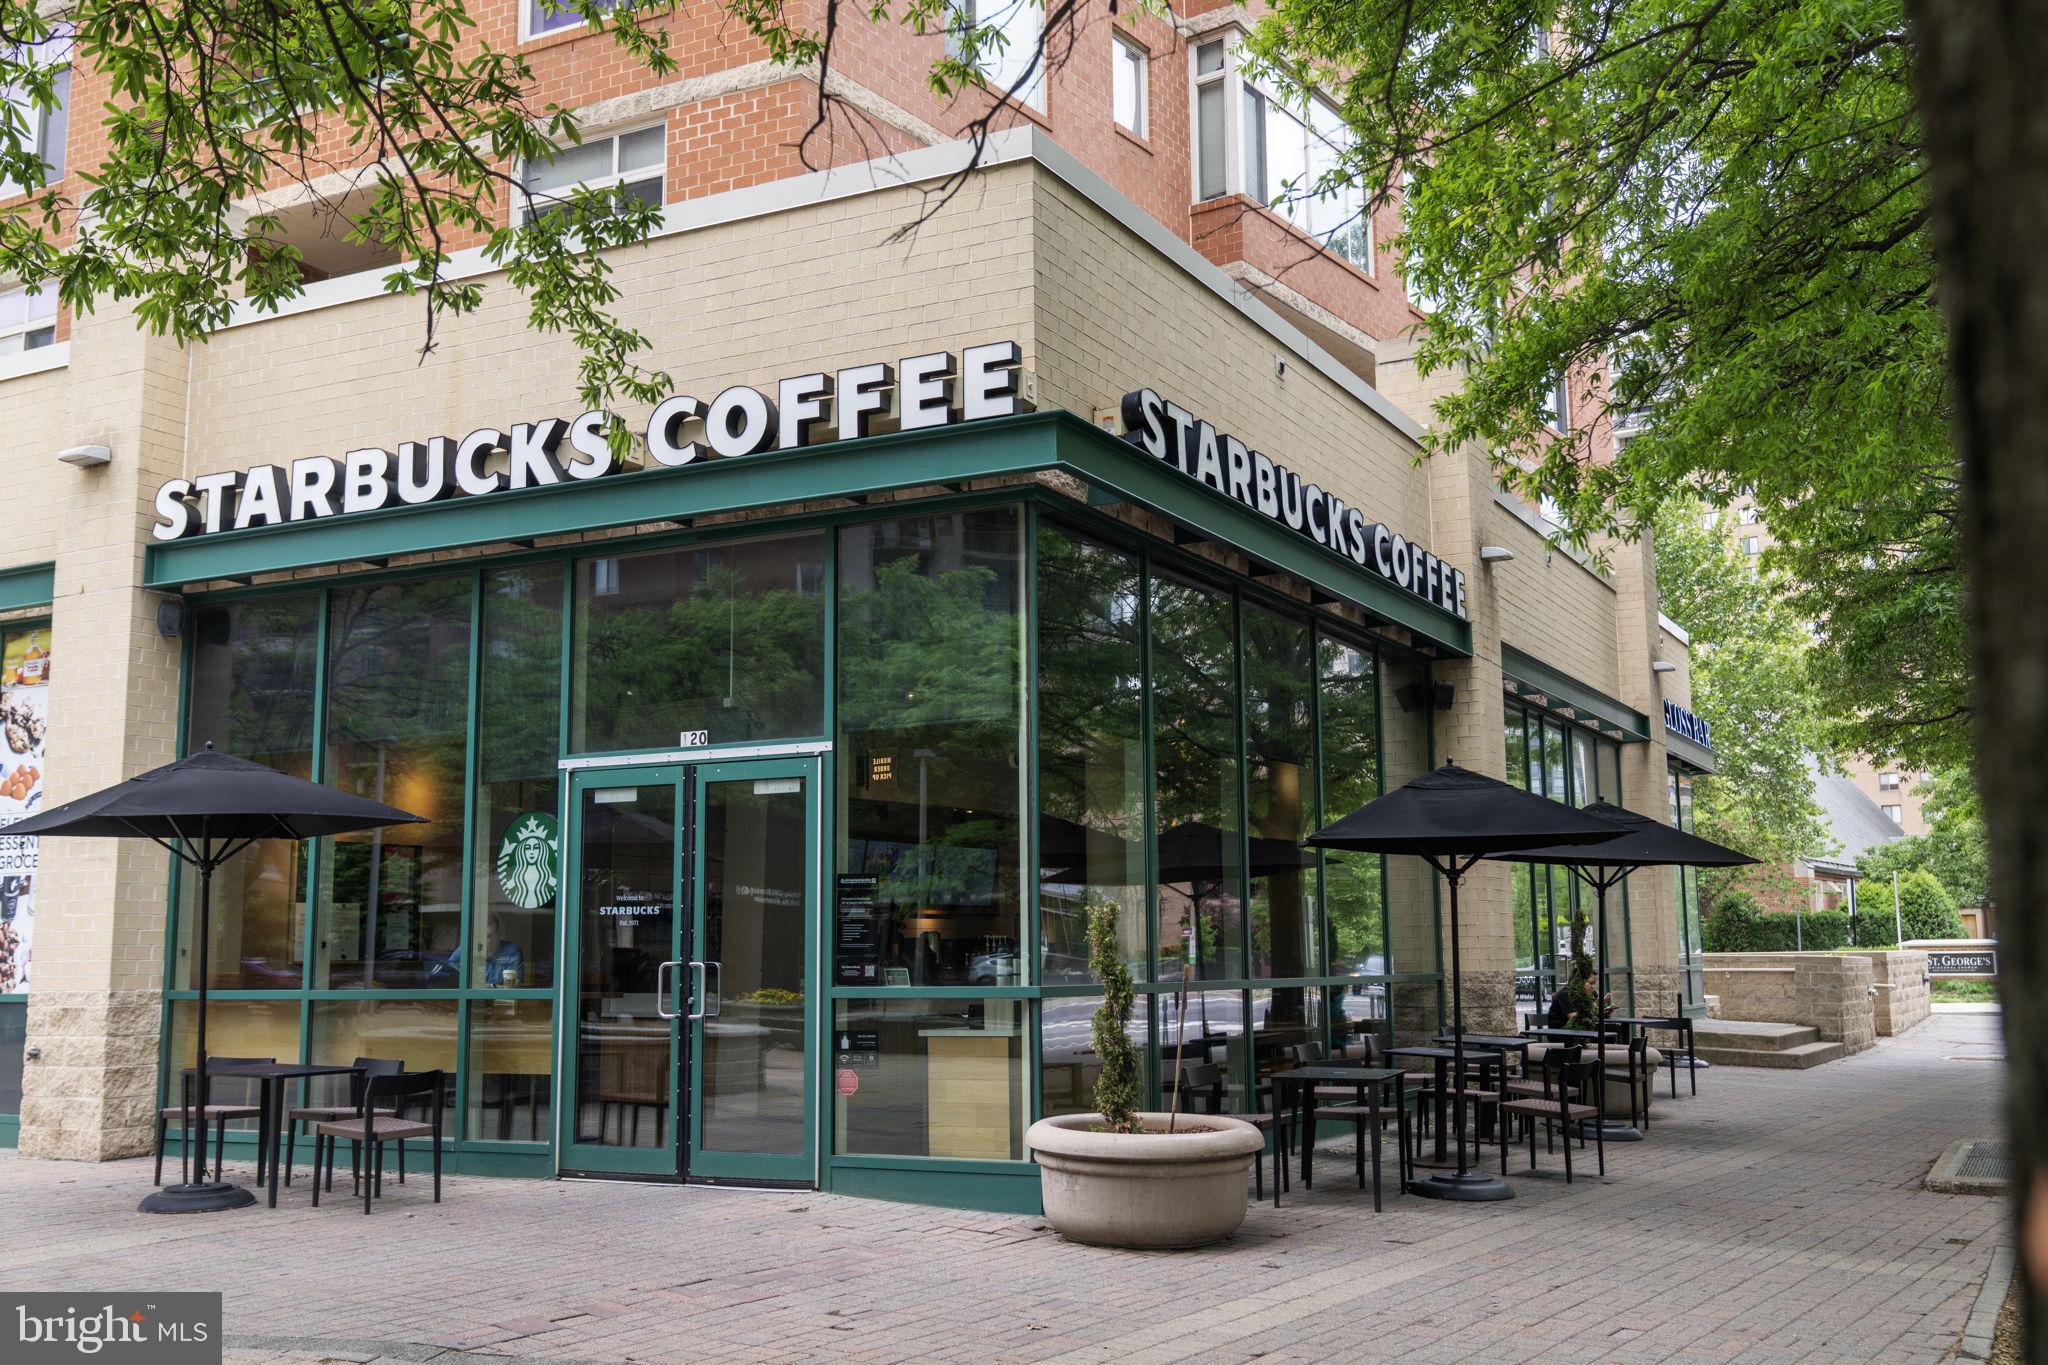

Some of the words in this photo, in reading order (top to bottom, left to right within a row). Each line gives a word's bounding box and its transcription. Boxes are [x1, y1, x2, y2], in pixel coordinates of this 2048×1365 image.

[152, 409, 624, 541] STARBUCKS
[646, 340, 1023, 467] COFFEE
[1122, 387, 1366, 566] STARBUCKS
[1367, 522, 1468, 620] COFFEE
[682, 731, 707, 746] 120
[1663, 696, 1692, 739] GLOSS
[1693, 714, 1712, 750] BAR
[600, 906, 660, 915] STARBUCKS
[1941, 955, 1991, 966] GEORGE'S
